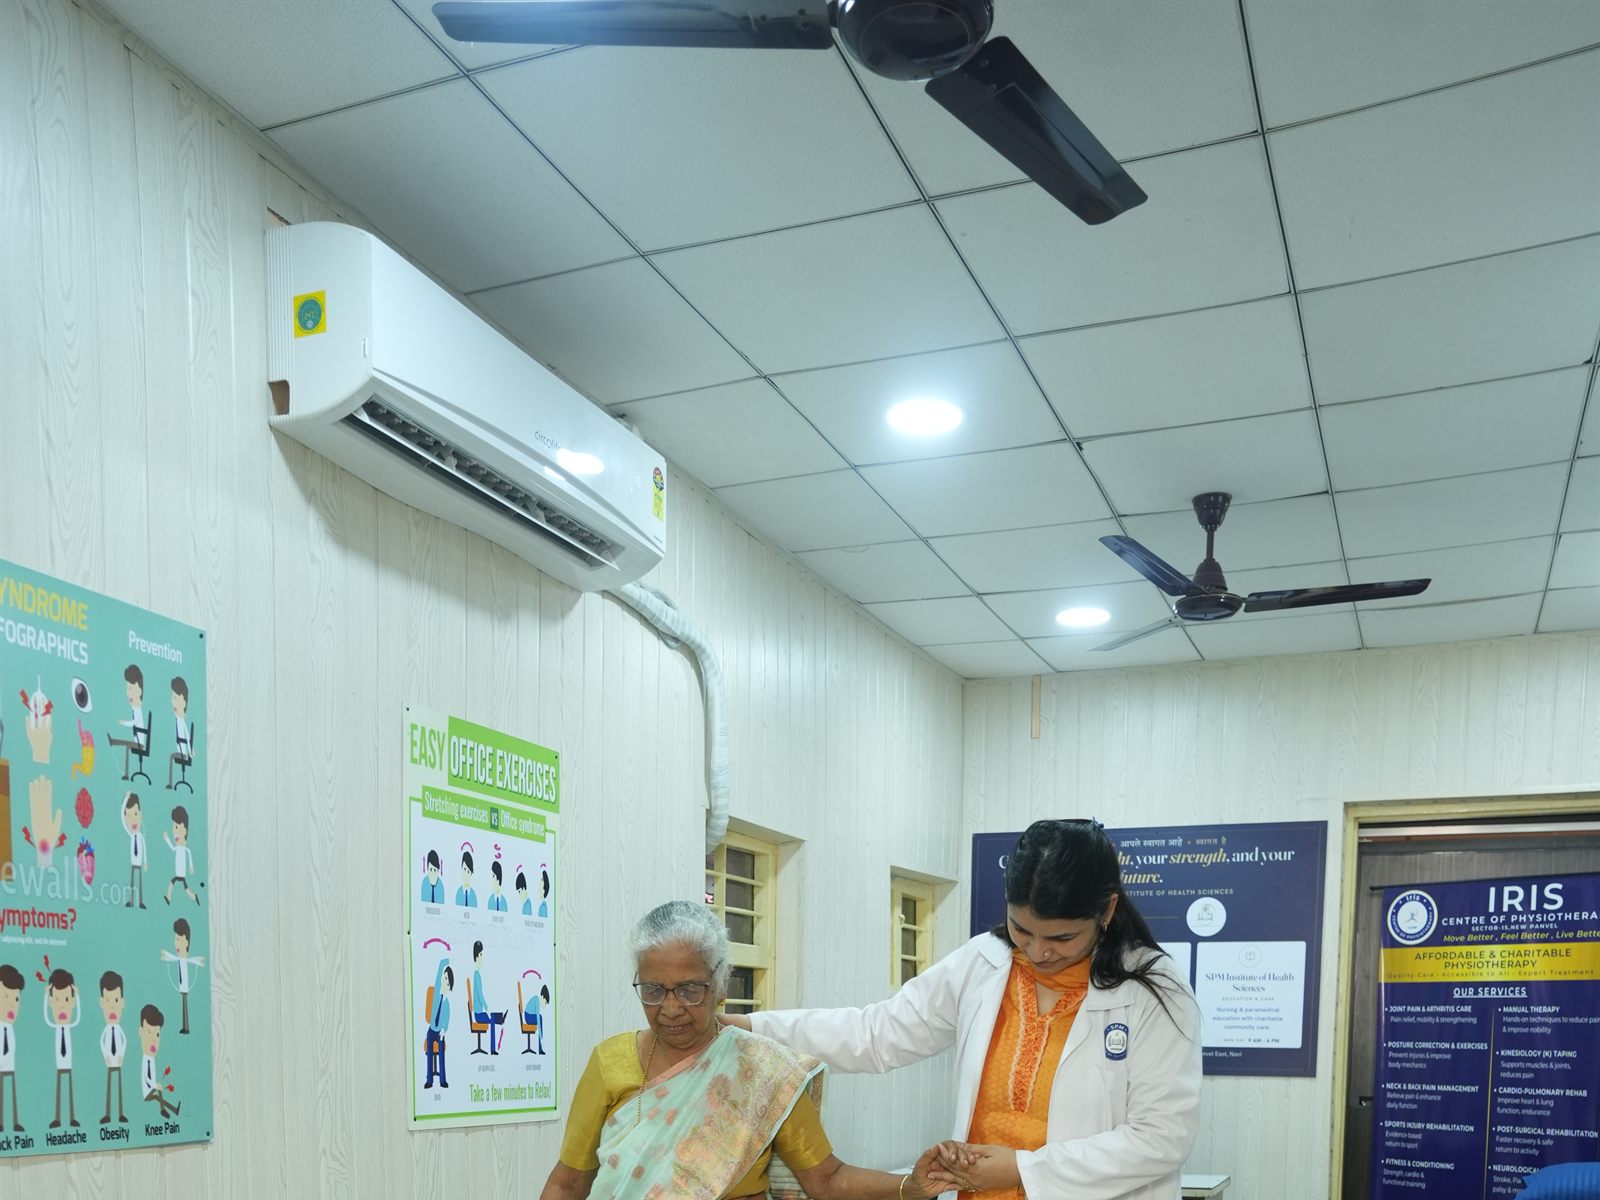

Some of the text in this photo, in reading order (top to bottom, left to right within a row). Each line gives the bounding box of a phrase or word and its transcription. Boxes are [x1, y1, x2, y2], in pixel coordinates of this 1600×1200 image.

[535, 431, 561, 450] circolif
[128, 630, 182, 664] Prevention
[410, 722, 557, 805] EASY OFFICE EXERCISES
[424, 791, 545, 836] Stretching exercises Office syndrome
[1120, 836, 1183, 848] आपले स्वागत आहे
[1135, 846, 1295, 869] your strength, and your
[1488, 882, 1564, 913] IRIS
[0, 906, 77, 935] ymptoms?
[1441, 911, 1598, 926] CENTRE OF PHYSIOTHERA
[1529, 922, 1558, 930] PANVEL
[1443, 934, 1465, 942] Move
[1467, 933, 1494, 941] Better
[1500, 932, 1519, 940] Feel
[1521, 931, 1549, 939] Better
[1556, 930, 1574, 938] Live
[1415, 948, 1572, 960] AFFORDABLE & CHARITABLE
[1444, 960, 1537, 969] PHYSIOTHERAPY
[1205, 972, 1295, 981] SPM Institute of Health
[1232, 984, 1266, 992] Sciences
[1453, 987, 1527, 997] OUR SERVICES
[1440, 1016, 1477, 1024] strengthening
[1530, 1016, 1561, 1024] techniques
[1508, 1026, 1529, 1034] improve
[1542, 1050, 1552, 1058] (K)
[1501, 1061, 1525, 1069] Supports
[469, 1084, 484, 1103] Take
[486, 1089, 490, 1101] a
[491, 1084, 502, 1102] few
[503, 1083, 526, 1101] minutes
[527, 1083, 534, 1100] to
[1498, 1087, 1587, 1097] CARDIO-PULMONARY REHAB
[1541, 1099, 1554, 1107] lung
[145, 1122, 180, 1136] Knee Pain
[1406, 1121, 1425, 1129] INJURY
[1426, 1123, 1474, 1132] REHABILITATION
[1497, 1125, 1598, 1138] POST-SURGICAL REHABILITATION
[46, 1130, 87, 1146] Headache
[100, 1127, 130, 1143] Obesity
[0, 1136, 34, 1151] ck Pain
[1385, 1158, 1454, 1170] FITNESS CONDITIONING
